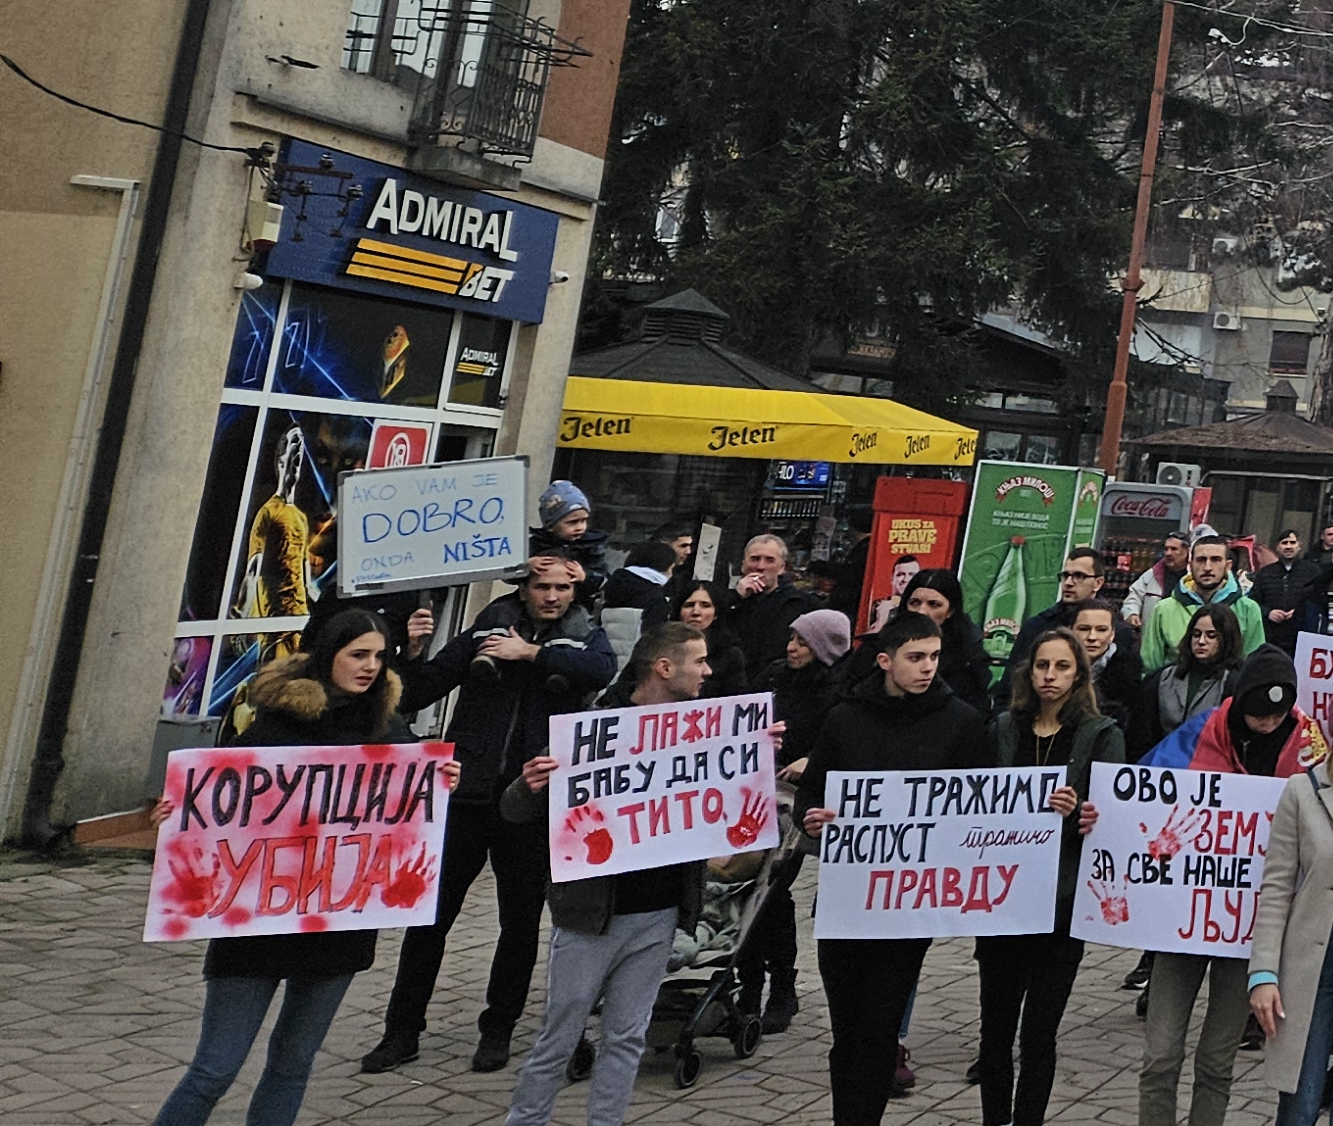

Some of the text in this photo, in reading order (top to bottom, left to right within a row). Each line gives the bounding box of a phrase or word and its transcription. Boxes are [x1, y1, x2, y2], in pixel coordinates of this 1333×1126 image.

[366, 178, 518, 262] ADMIRAL
[458, 263, 516, 302] BET
[460, 347, 498, 365] ADMIRAL
[560, 417, 631, 442] Jelen
[708, 426, 775, 451] Jelen
[849, 432, 877, 457] Jelen
[904, 435, 930, 458] Jelen
[954, 437, 978, 460] Jele
[352, 473, 498, 504] AKO VAM JE
[1111, 495, 1170, 517] Coca-Cola
[362, 497, 504, 543] DOBRO,
[888, 529, 937, 543] PRAVE
[361, 534, 511, 571] ONDA NIŠTA
[891, 543, 931, 554] STVARI
[572, 703, 767, 766] НЕ ЛАЖИ МИ
[568, 742, 758, 808] БАБУ ДА СИ
[1113, 767, 1222, 807] ОВО ЈЕ
[180, 761, 437, 831] КОРУПЦИЈА
[838, 773, 1060, 818] НЕ ТРАЖИМО
[823, 822, 936, 864] РАСПУСТ
[208, 833, 393, 918] УБИЈА
[1091, 849, 1251, 888] ЗА СВЕ НАШЕ
[865, 864, 1019, 914] ПРАВДУ
